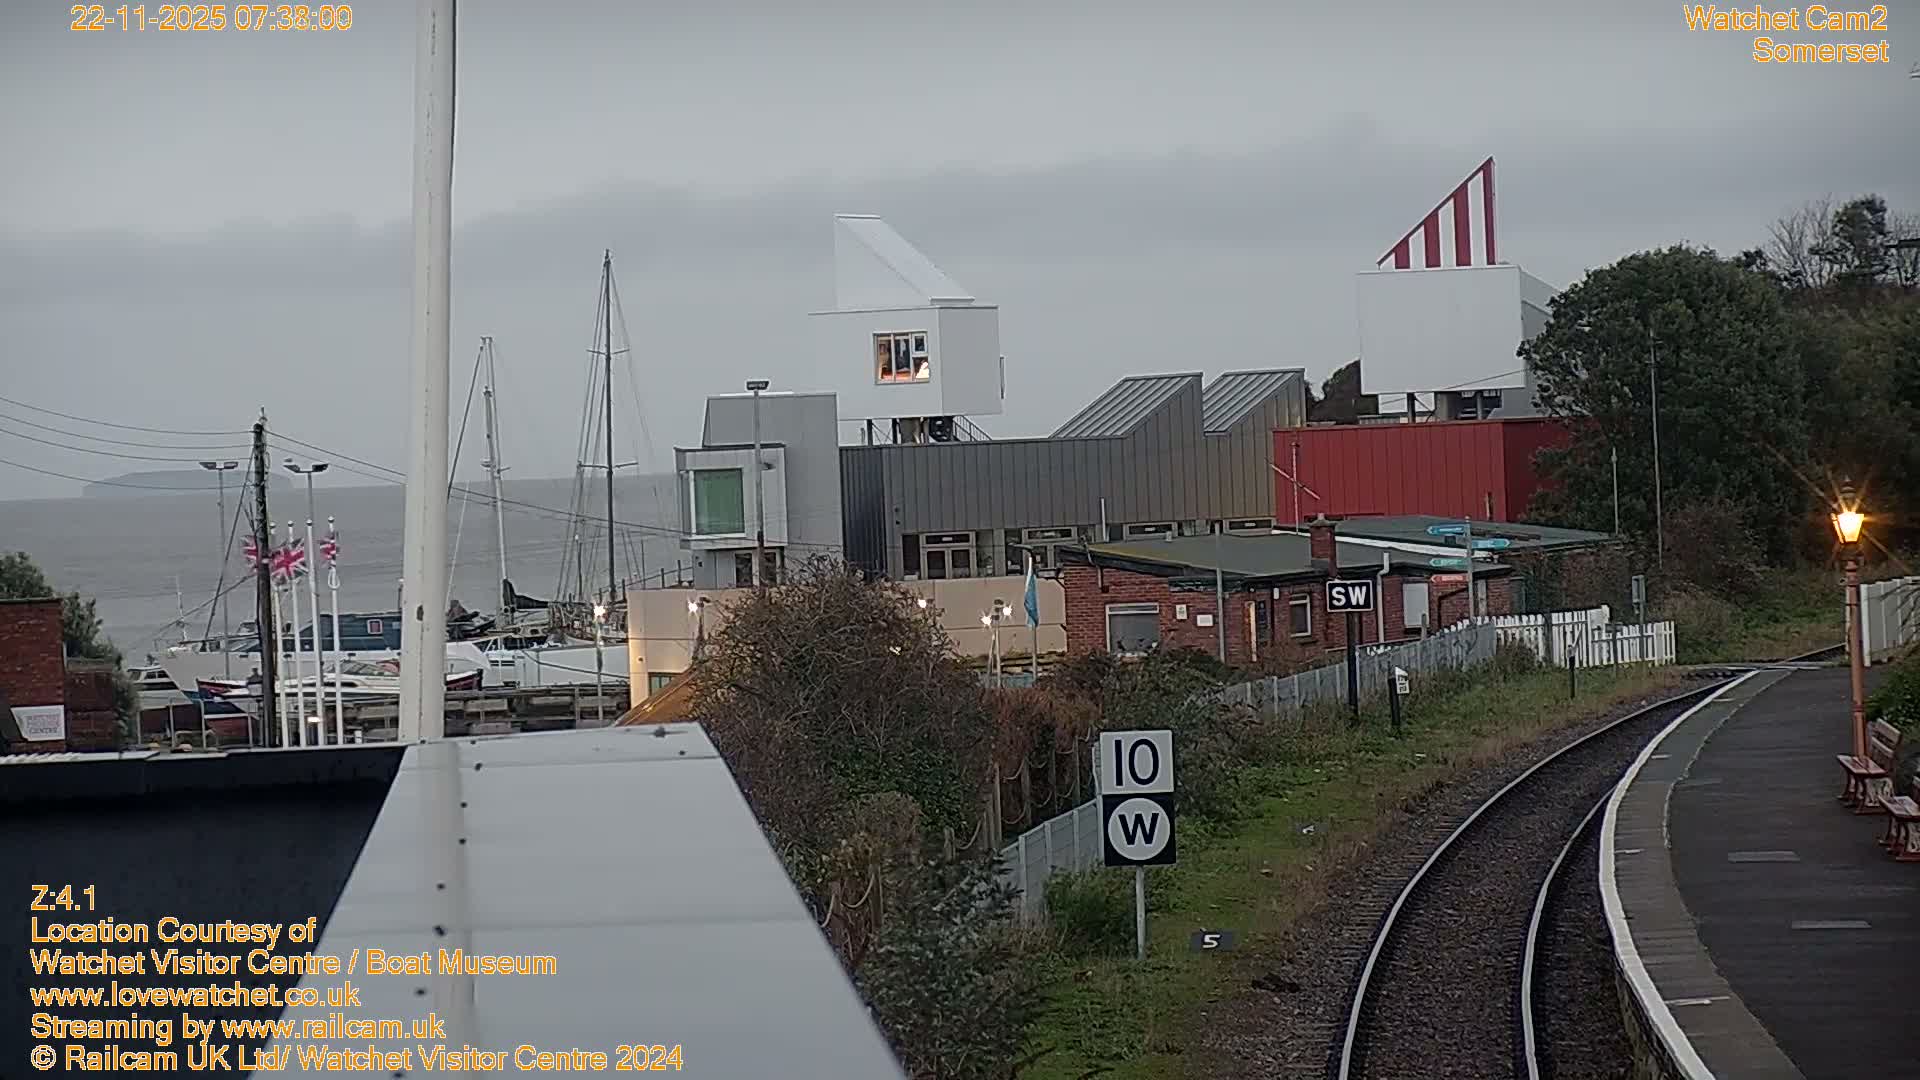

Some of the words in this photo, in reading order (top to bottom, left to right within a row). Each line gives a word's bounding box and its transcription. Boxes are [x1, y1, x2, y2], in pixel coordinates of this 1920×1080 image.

[1331, 585, 1367, 607] SW
[1114, 738, 1160, 787] 10
[1118, 812, 1160, 846] W
[1202, 933, 1221, 949] 5
